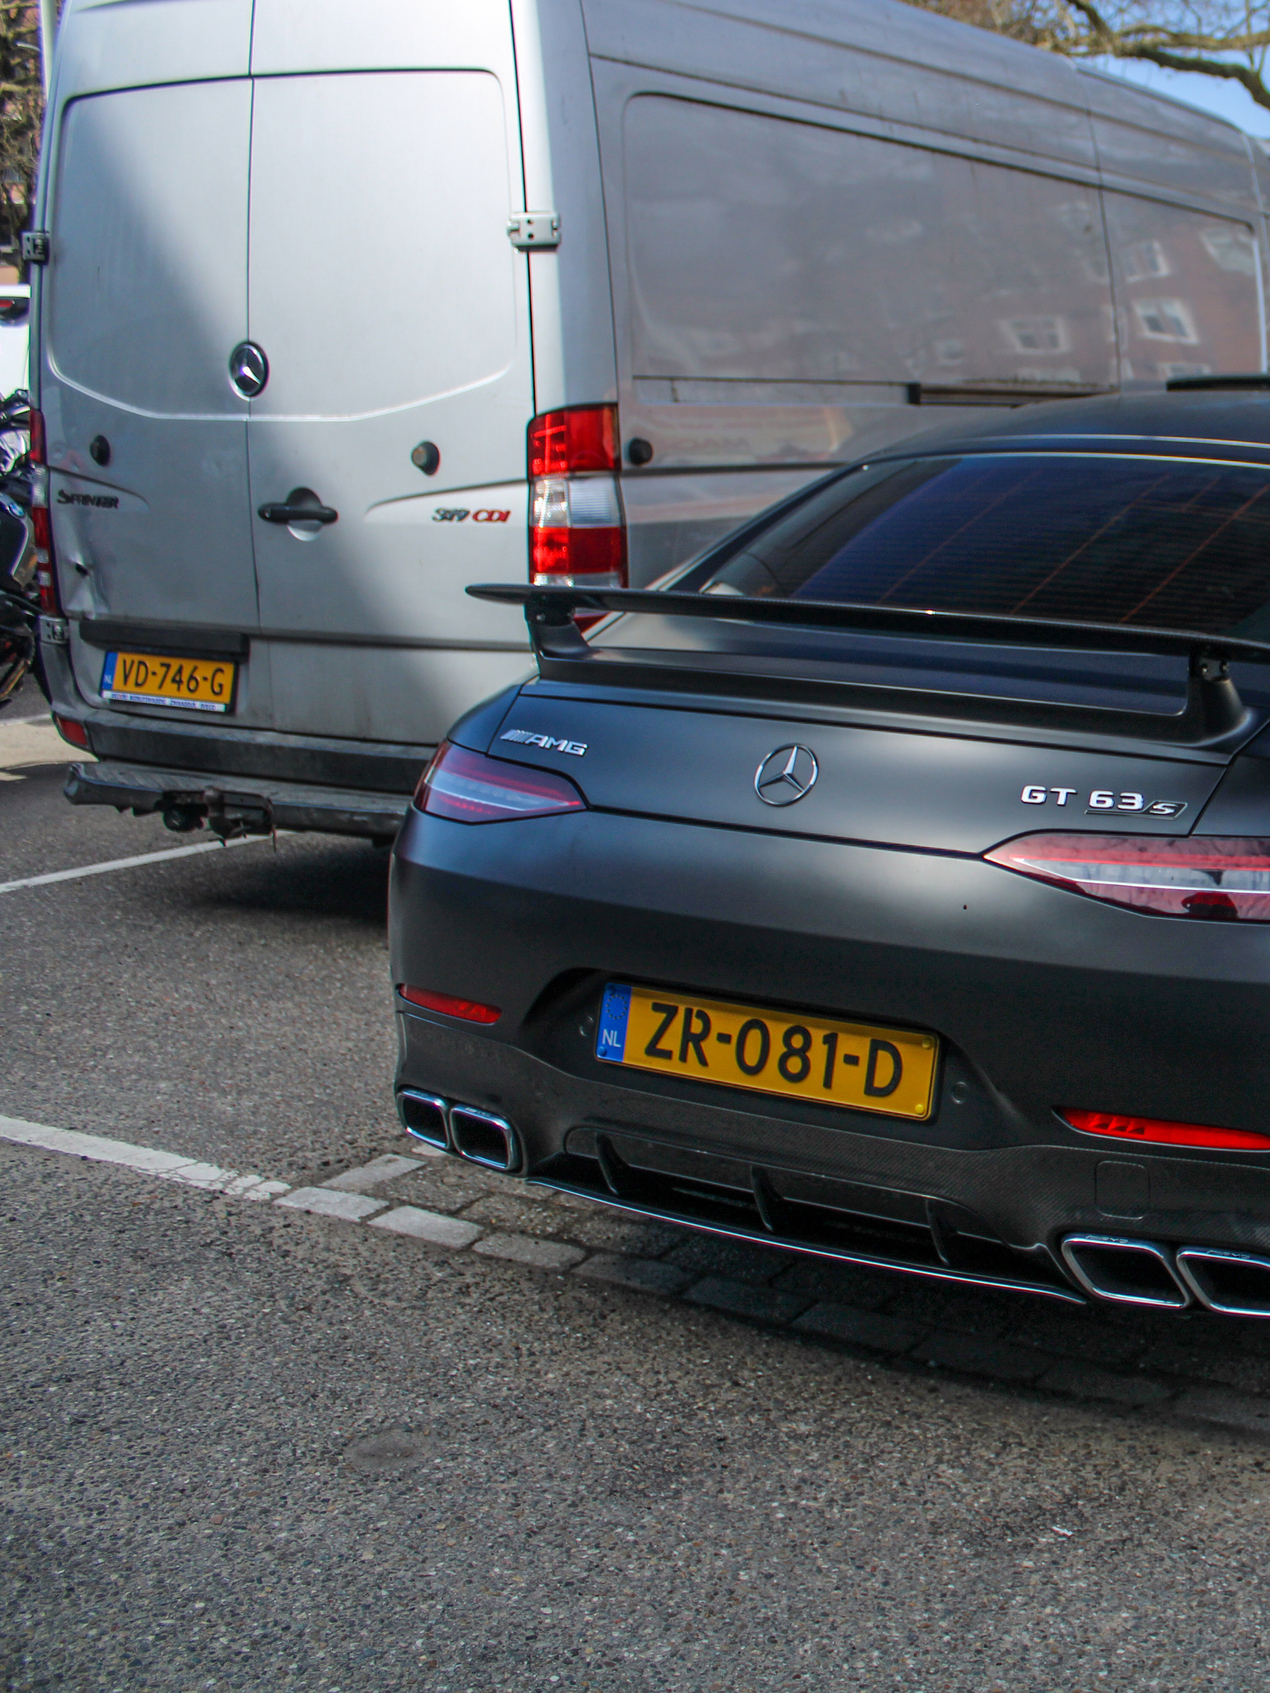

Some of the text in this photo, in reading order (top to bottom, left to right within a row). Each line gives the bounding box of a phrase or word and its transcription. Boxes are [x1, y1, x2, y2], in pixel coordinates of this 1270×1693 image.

[473, 509, 511, 523] CDI
[122, 658, 226, 696] VD-746-G
[524, 733, 589, 756] AMG
[1021, 785, 1077, 806] GT
[602, 1028, 621, 1048] NL
[644, 1001, 904, 1099] ZR-081-D
